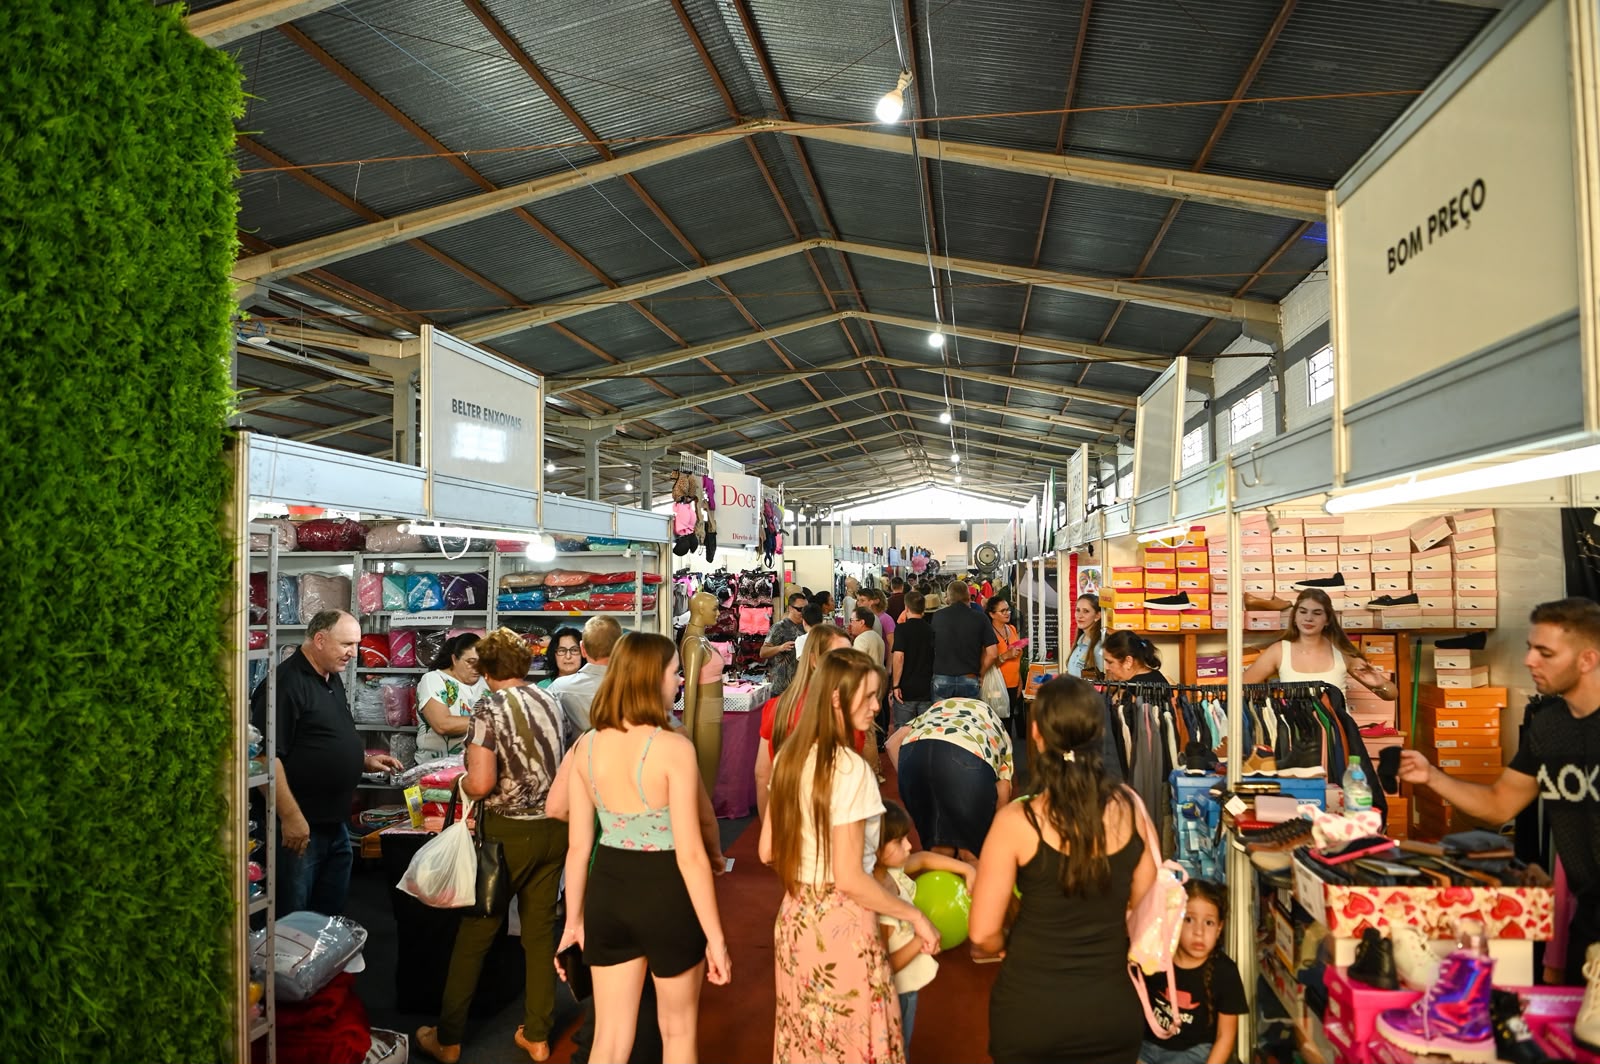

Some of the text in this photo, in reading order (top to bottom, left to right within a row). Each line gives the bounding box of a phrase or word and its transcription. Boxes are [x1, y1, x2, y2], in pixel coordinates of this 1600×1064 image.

[1387, 178, 1486, 275] BOM PREÇO
[451, 398, 522, 430] BELTER ENXOVAIS
[721, 484, 756, 509] Doce
